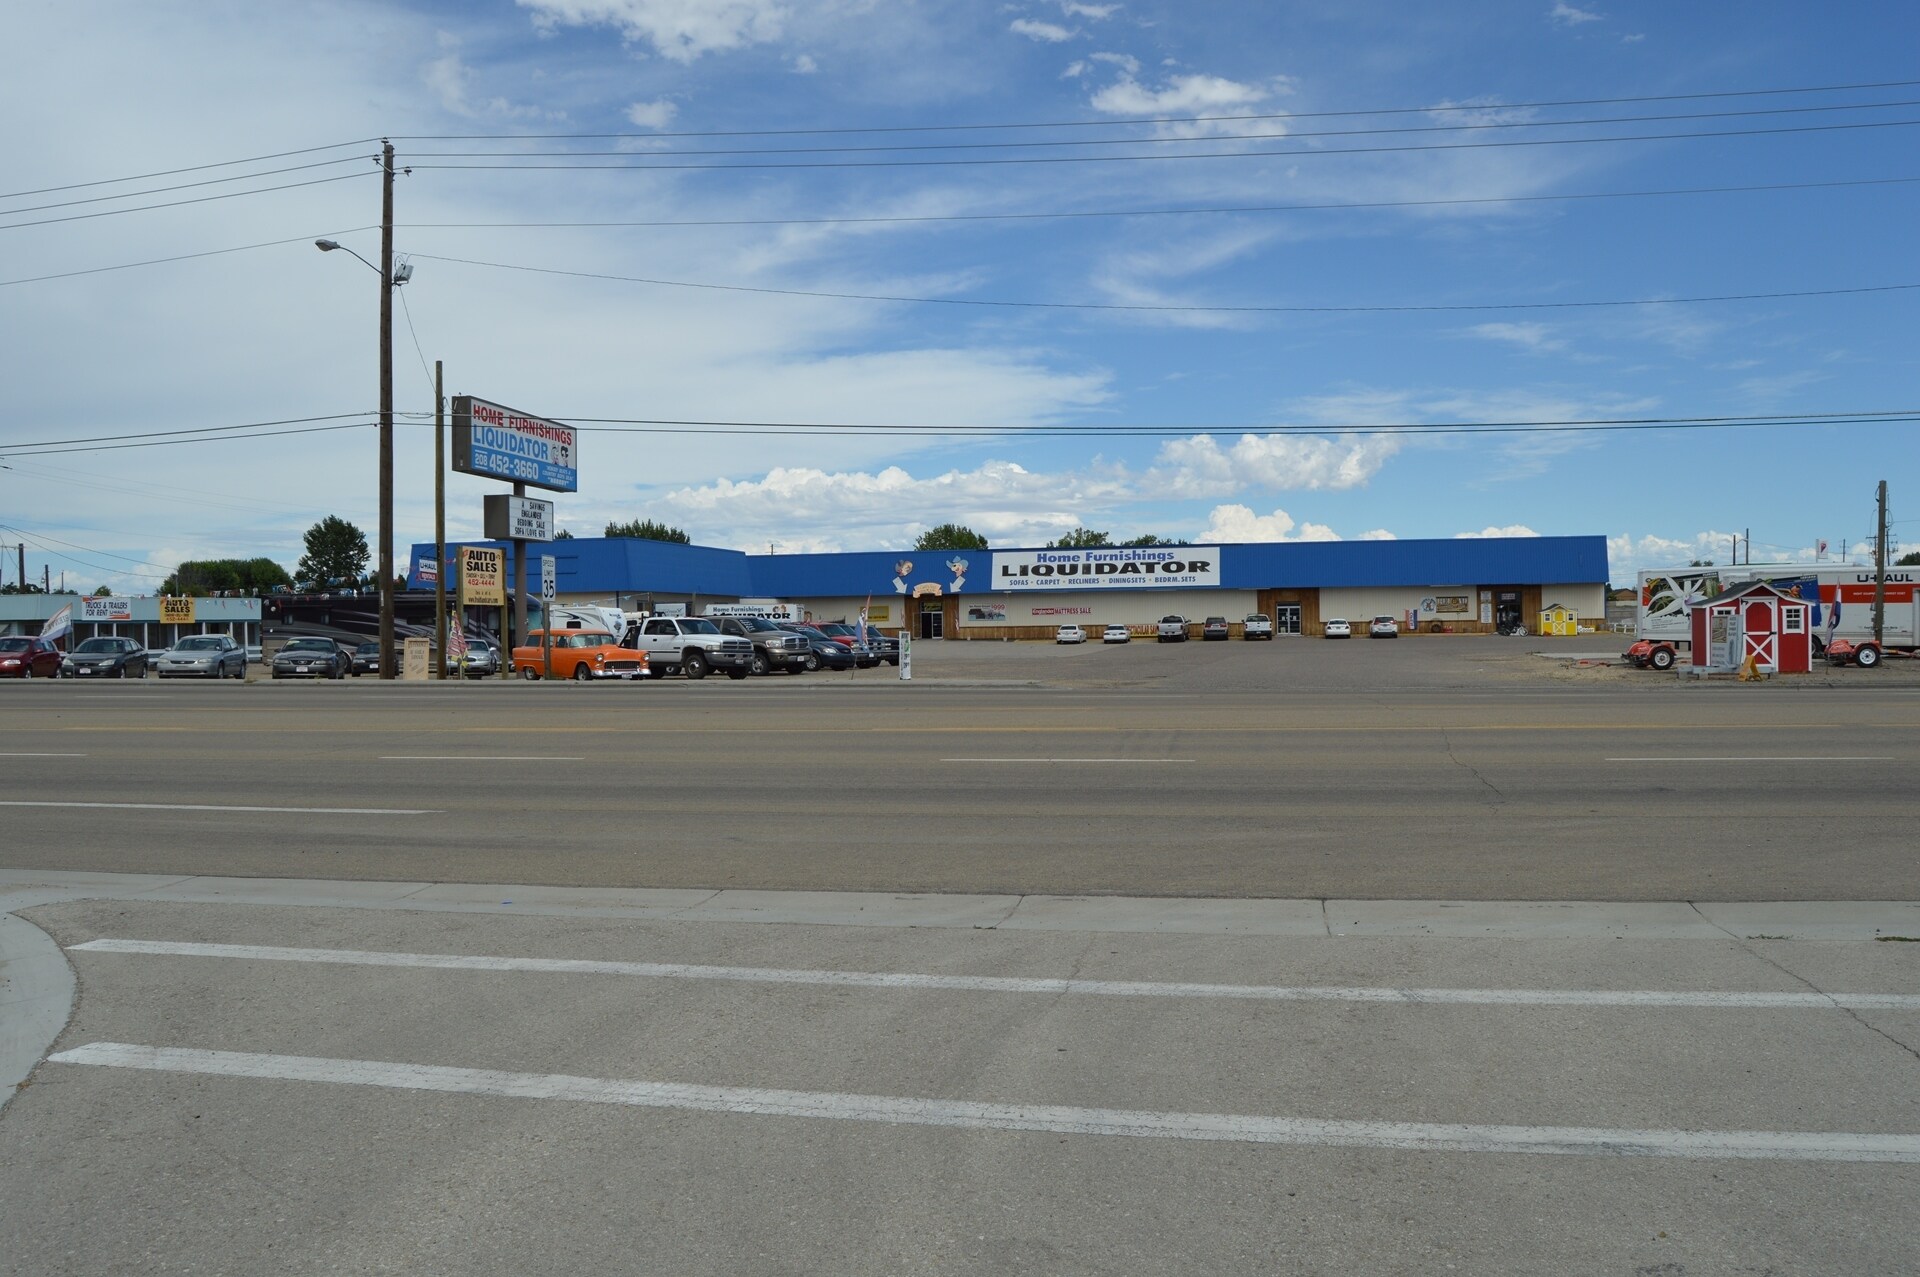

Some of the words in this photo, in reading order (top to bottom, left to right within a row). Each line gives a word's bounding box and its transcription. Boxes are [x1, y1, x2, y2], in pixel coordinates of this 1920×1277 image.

[473, 404, 504, 428] HOME
[509, 414, 572, 446] FURNISHINGS
[473, 424, 548, 460] LIQUIDATOR
[474, 453, 488, 465] 208
[489, 454, 539, 480] 452-3660
[529, 502, 545, 511] SAVINGS
[536, 521, 545, 529] SALE
[468, 550, 496, 562] AUTO
[1037, 552, 1080, 563] Home
[1086, 550, 1175, 562] Furnishings
[420, 563, 437, 571] U-HAUL
[466, 561, 497, 573] SALES
[543, 559, 554, 567] SPEED
[543, 569, 553, 577] LIMIT
[1002, 561, 1211, 577] LIQUIDATOR
[467, 578, 495, 586] 452-4444
[543, 579, 554, 598] 35
[85, 601, 102, 609] TRUCKS
[108, 601, 128, 609] TRAILERS
[1054, 607, 1079, 615] MATTRESS
